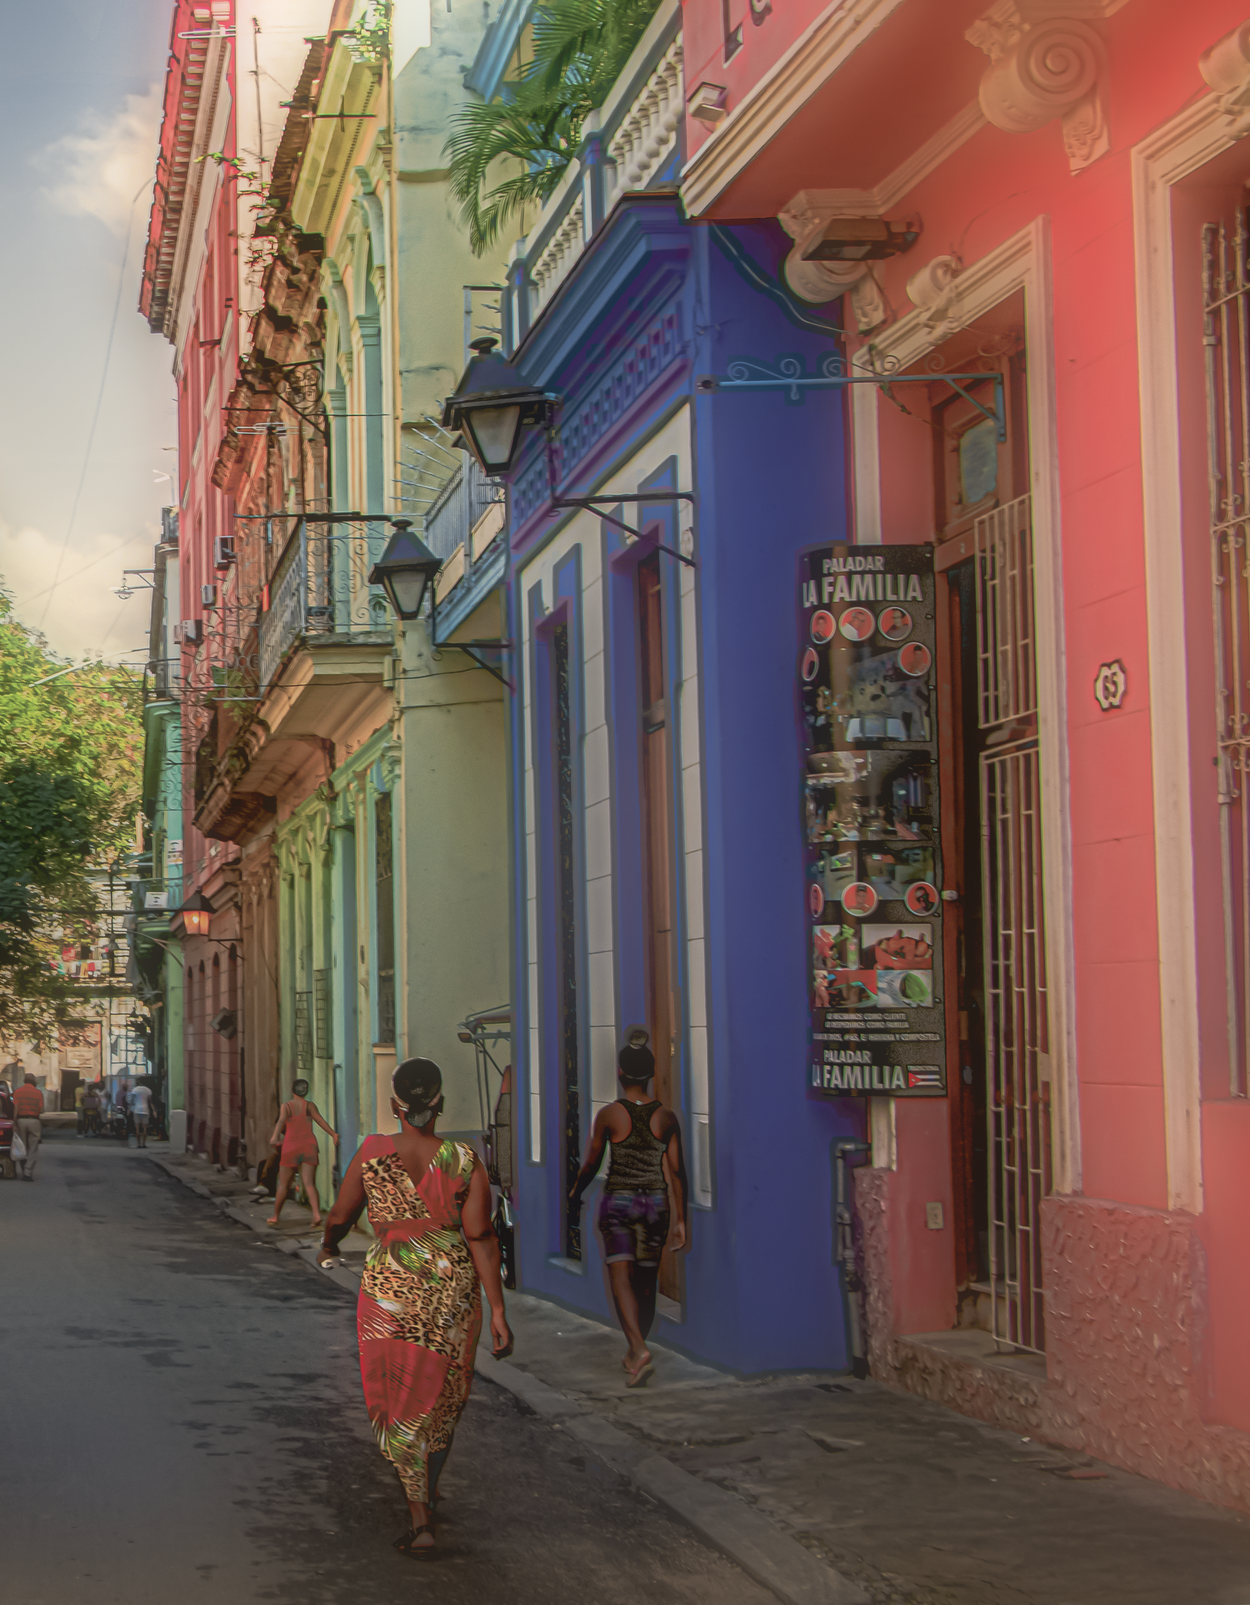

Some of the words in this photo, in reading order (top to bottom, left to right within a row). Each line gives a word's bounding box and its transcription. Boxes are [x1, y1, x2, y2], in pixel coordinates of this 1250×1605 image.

[822, 556, 886, 574] PALADAR
[803, 580, 819, 608] LA
[822, 574, 924, 603] FAMILIA
[823, 1050, 872, 1064] PALADAR
[823, 1065, 907, 1089] FAMILIA
